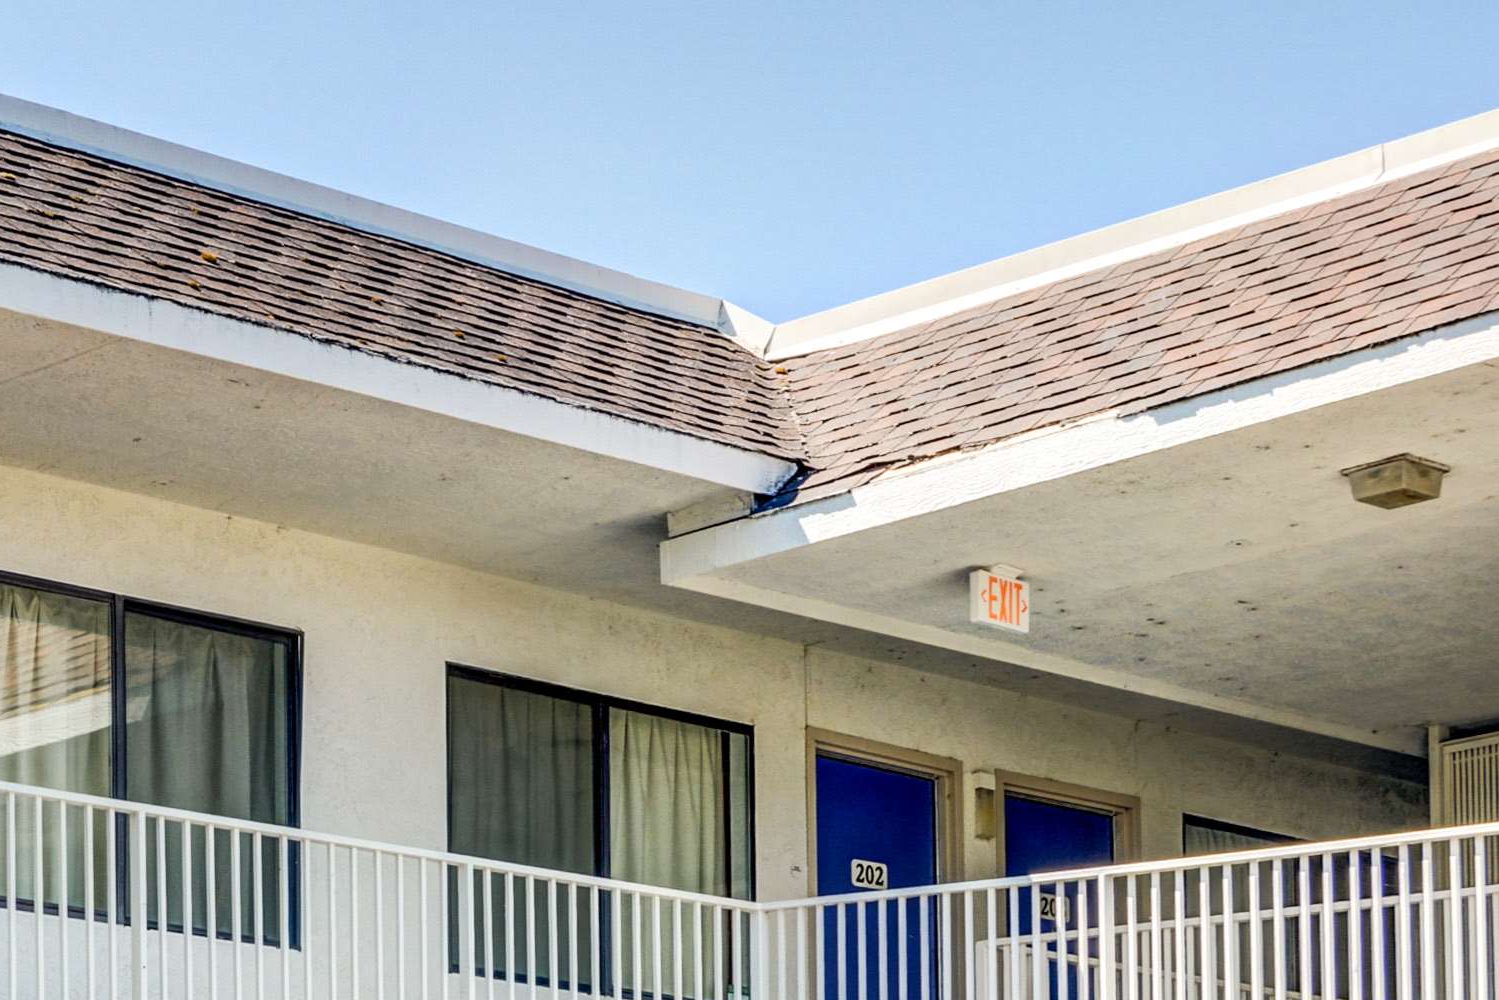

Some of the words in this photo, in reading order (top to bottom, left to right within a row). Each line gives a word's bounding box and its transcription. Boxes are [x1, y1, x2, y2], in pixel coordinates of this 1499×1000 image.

[988, 575, 1023, 625] EXIT
[855, 863, 884, 886] 202
[1041, 896, 1067, 918] 20
